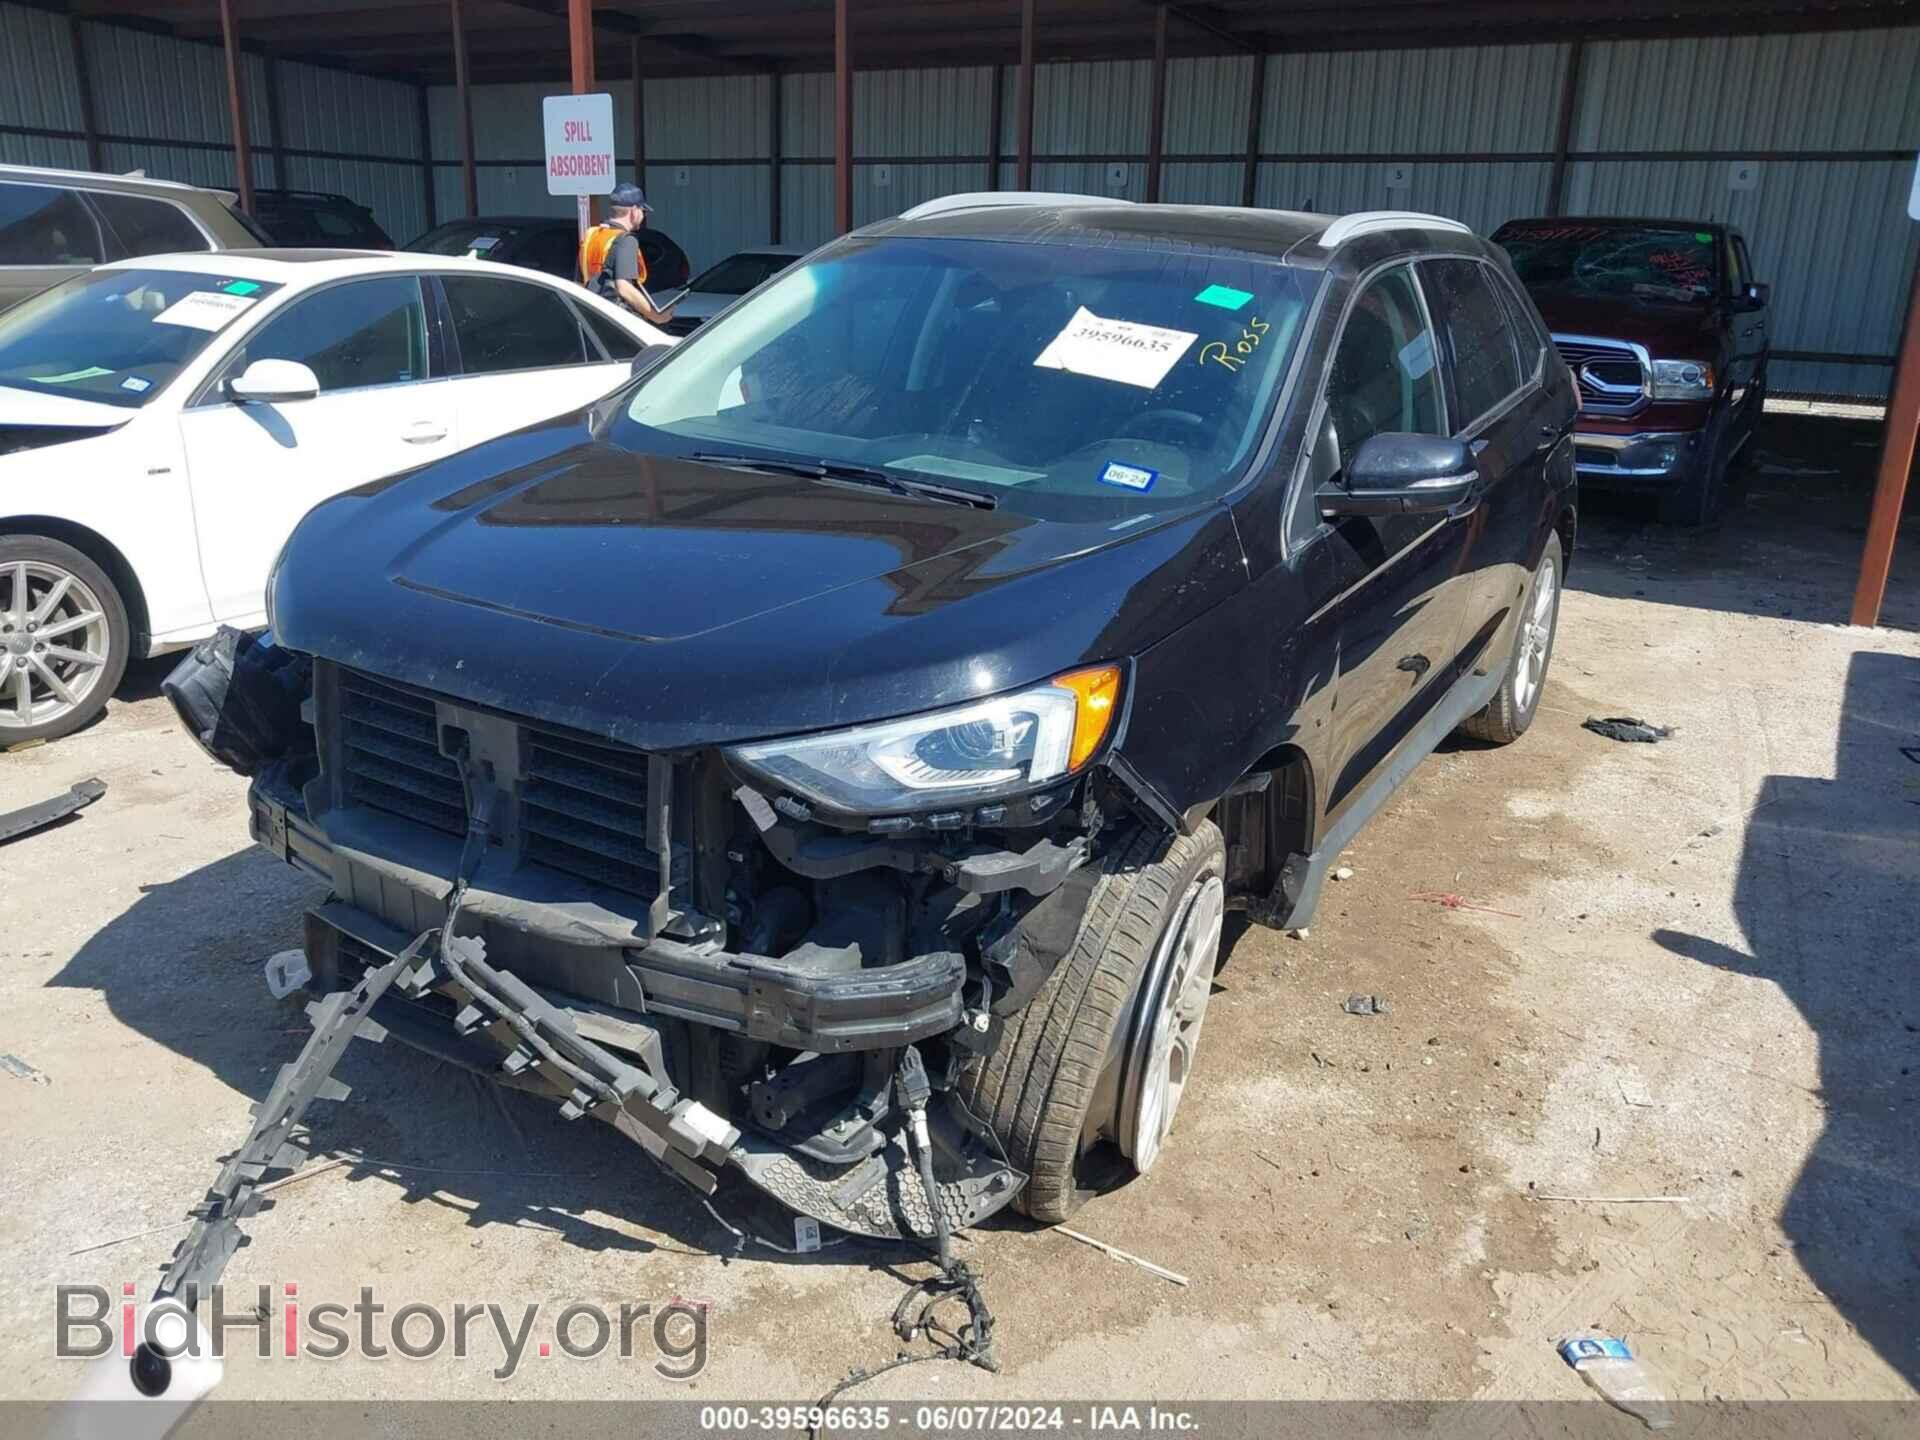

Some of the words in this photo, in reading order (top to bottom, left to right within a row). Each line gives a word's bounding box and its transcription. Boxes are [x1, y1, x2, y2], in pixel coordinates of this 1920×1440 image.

[564, 120, 592, 142] SPILL
[550, 153, 610, 177] ABSORBENT
[1739, 169, 1748, 180] 6
[1073, 328, 1172, 352] 39596635
